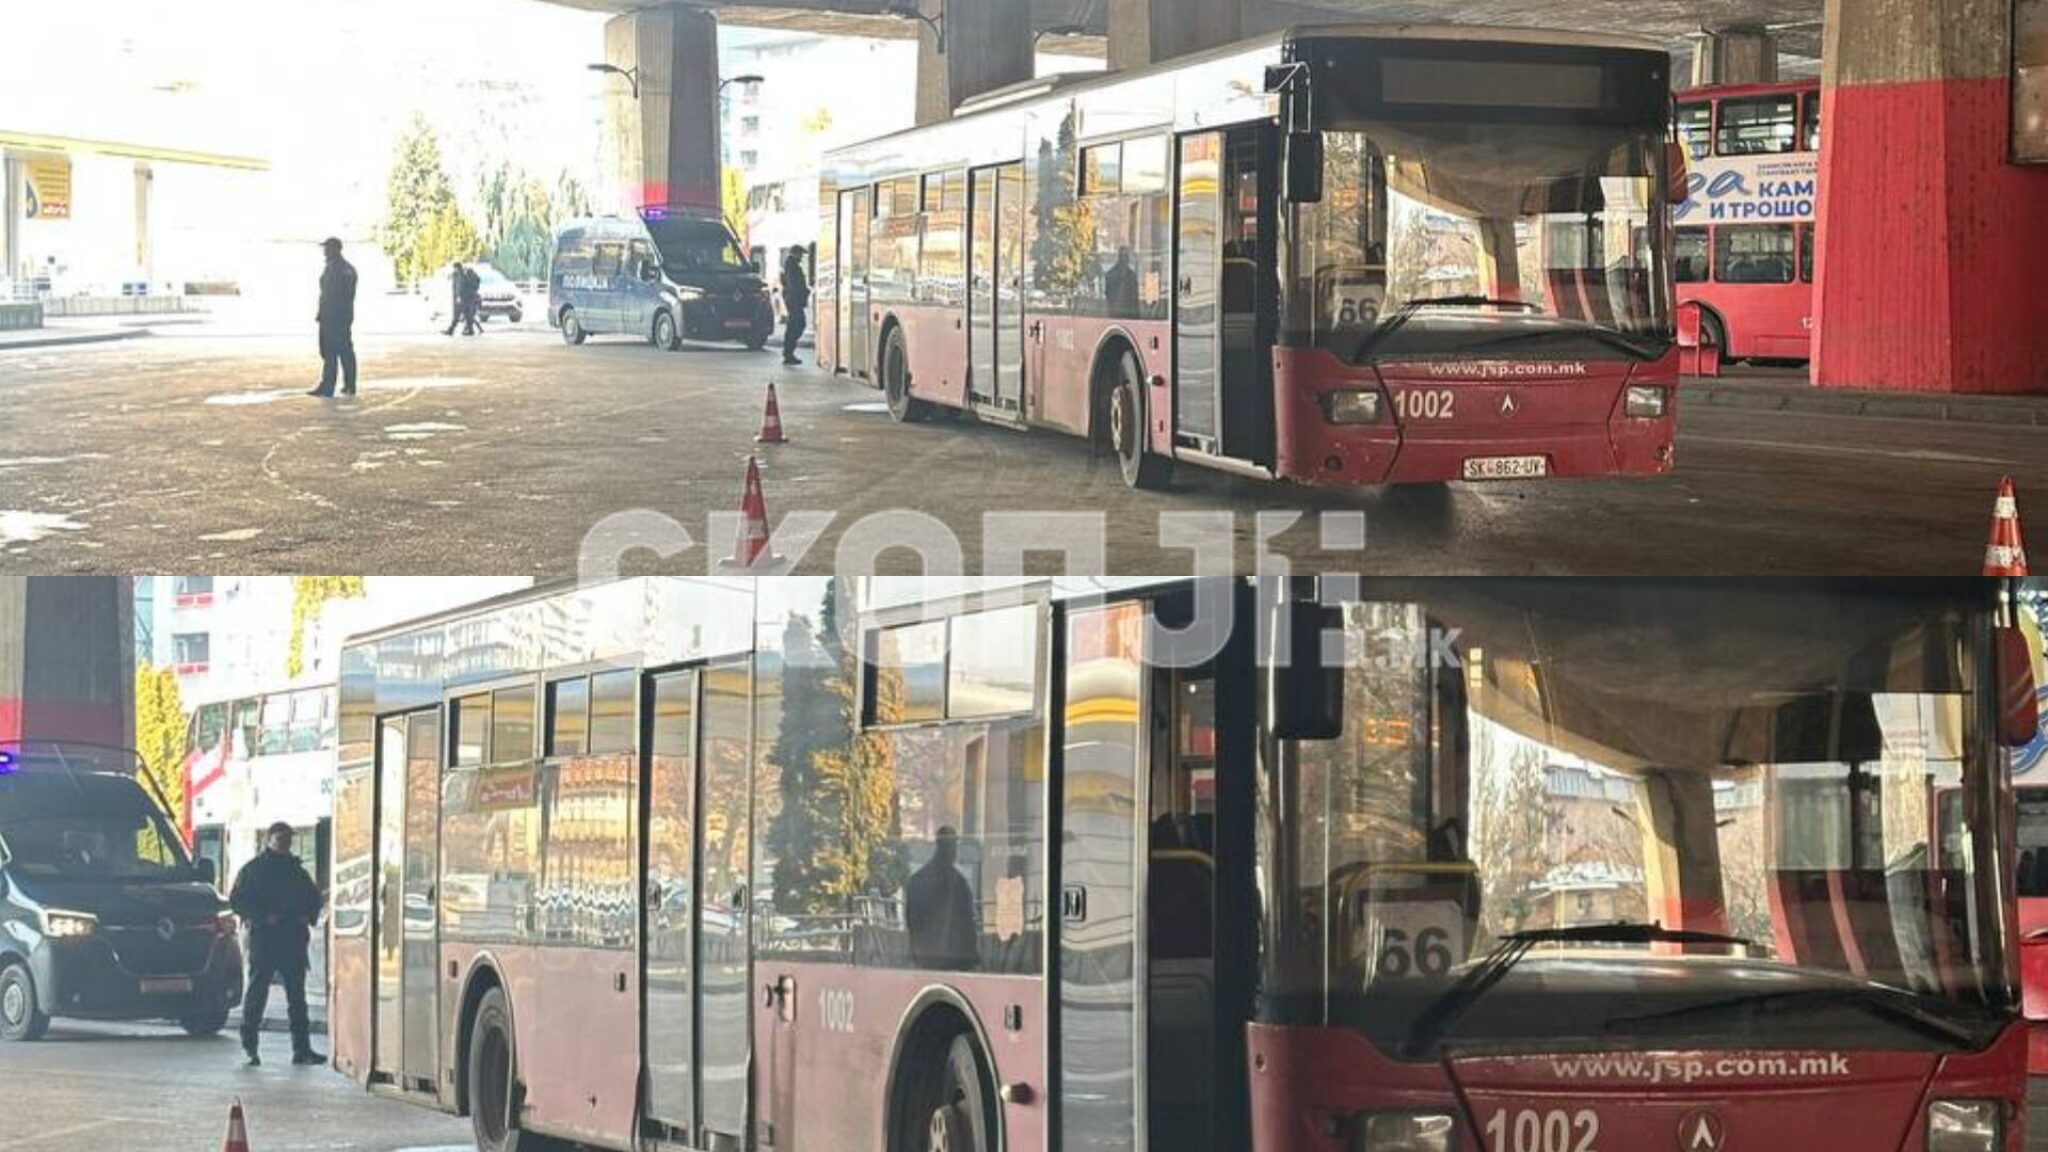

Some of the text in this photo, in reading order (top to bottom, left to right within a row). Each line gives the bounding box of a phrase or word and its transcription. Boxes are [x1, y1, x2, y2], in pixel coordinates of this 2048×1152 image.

[1429, 361, 1587, 378] www.jsp.com.mk
[1394, 390, 1454, 418] 1002
[1378, 925, 1452, 978] 66
[819, 989, 854, 1032] 1002
[1553, 1052, 1850, 1083] www.jsp.com.mk
[1486, 1108, 1600, 1152] 1002
